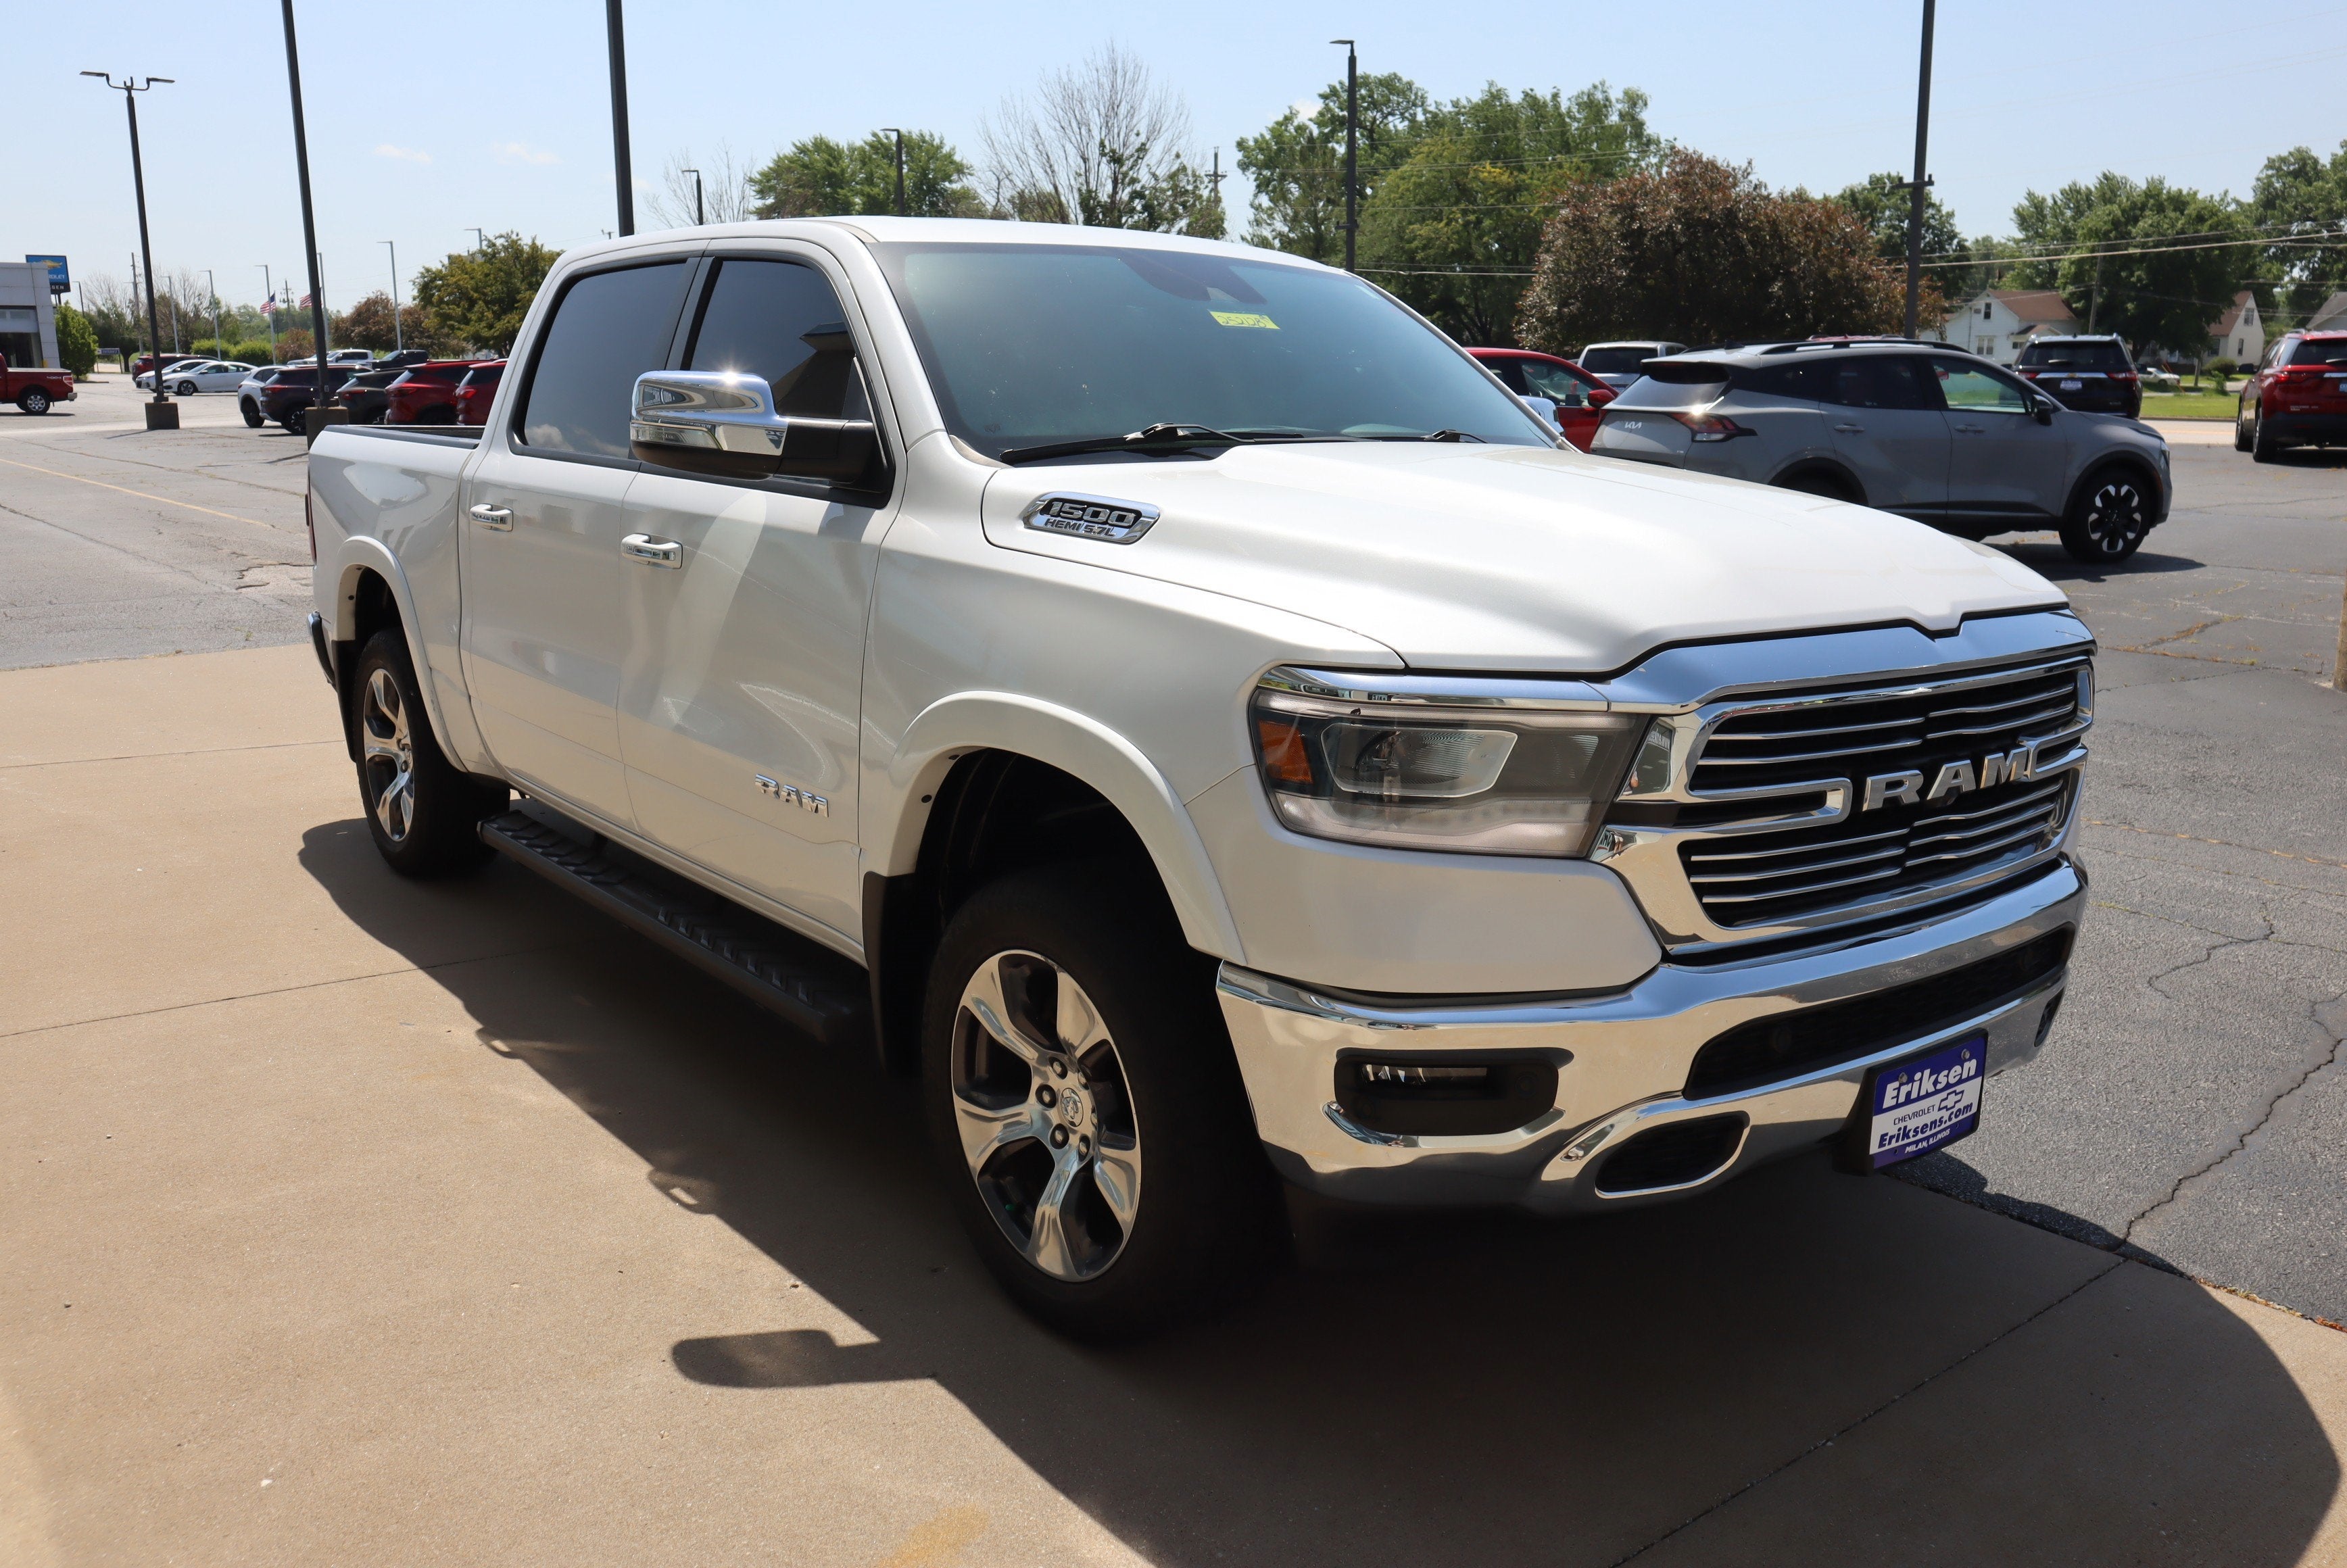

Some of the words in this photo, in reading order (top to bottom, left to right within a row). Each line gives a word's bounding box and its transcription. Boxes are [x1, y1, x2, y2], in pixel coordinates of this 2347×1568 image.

[1044, 518, 1082, 532] HEMI
[1083, 524, 1116, 537] 5.7L
[1048, 501, 1136, 526] 1500
[754, 774, 829, 818] RAM
[1862, 747, 2028, 812] RAM
[1882, 1058, 1977, 1109] Eriksen
[1878, 1102, 1973, 1149] Eriksens.com
[1893, 1104, 1936, 1126] CHEVROLET
[1929, 1128, 1951, 1146] ILLINOIS
